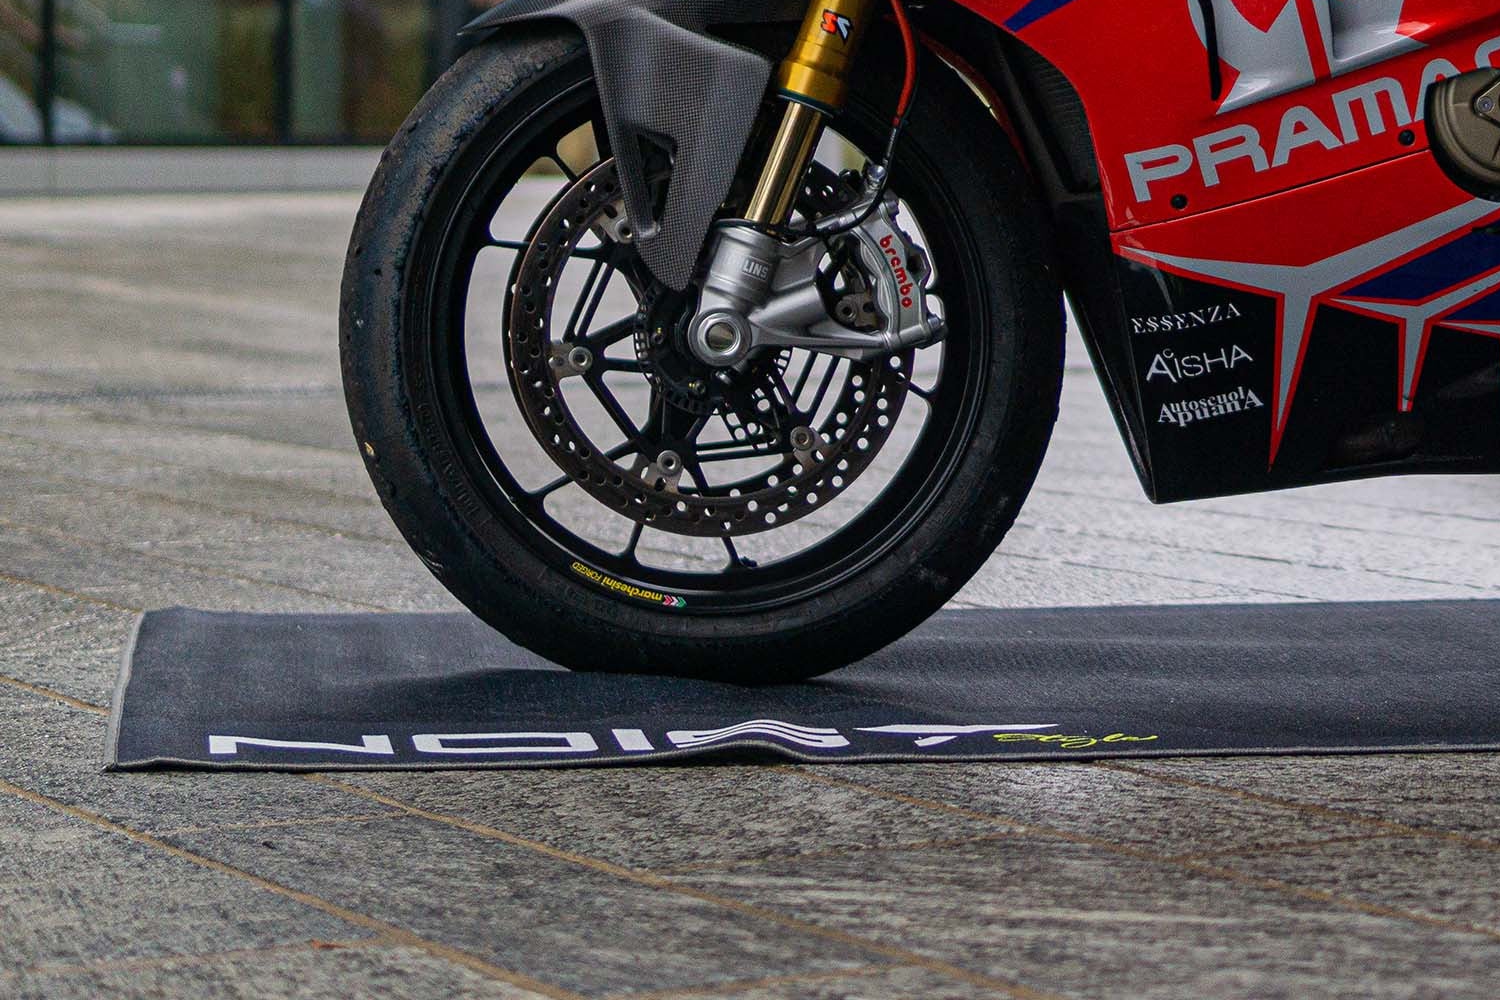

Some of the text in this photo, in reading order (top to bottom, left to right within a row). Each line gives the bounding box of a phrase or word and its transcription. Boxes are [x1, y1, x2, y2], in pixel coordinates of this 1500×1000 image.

[879, 233, 913, 308] brembo
[1131, 303, 1241, 334] ESSENZA
[602, 575, 663, 602] marchesini
